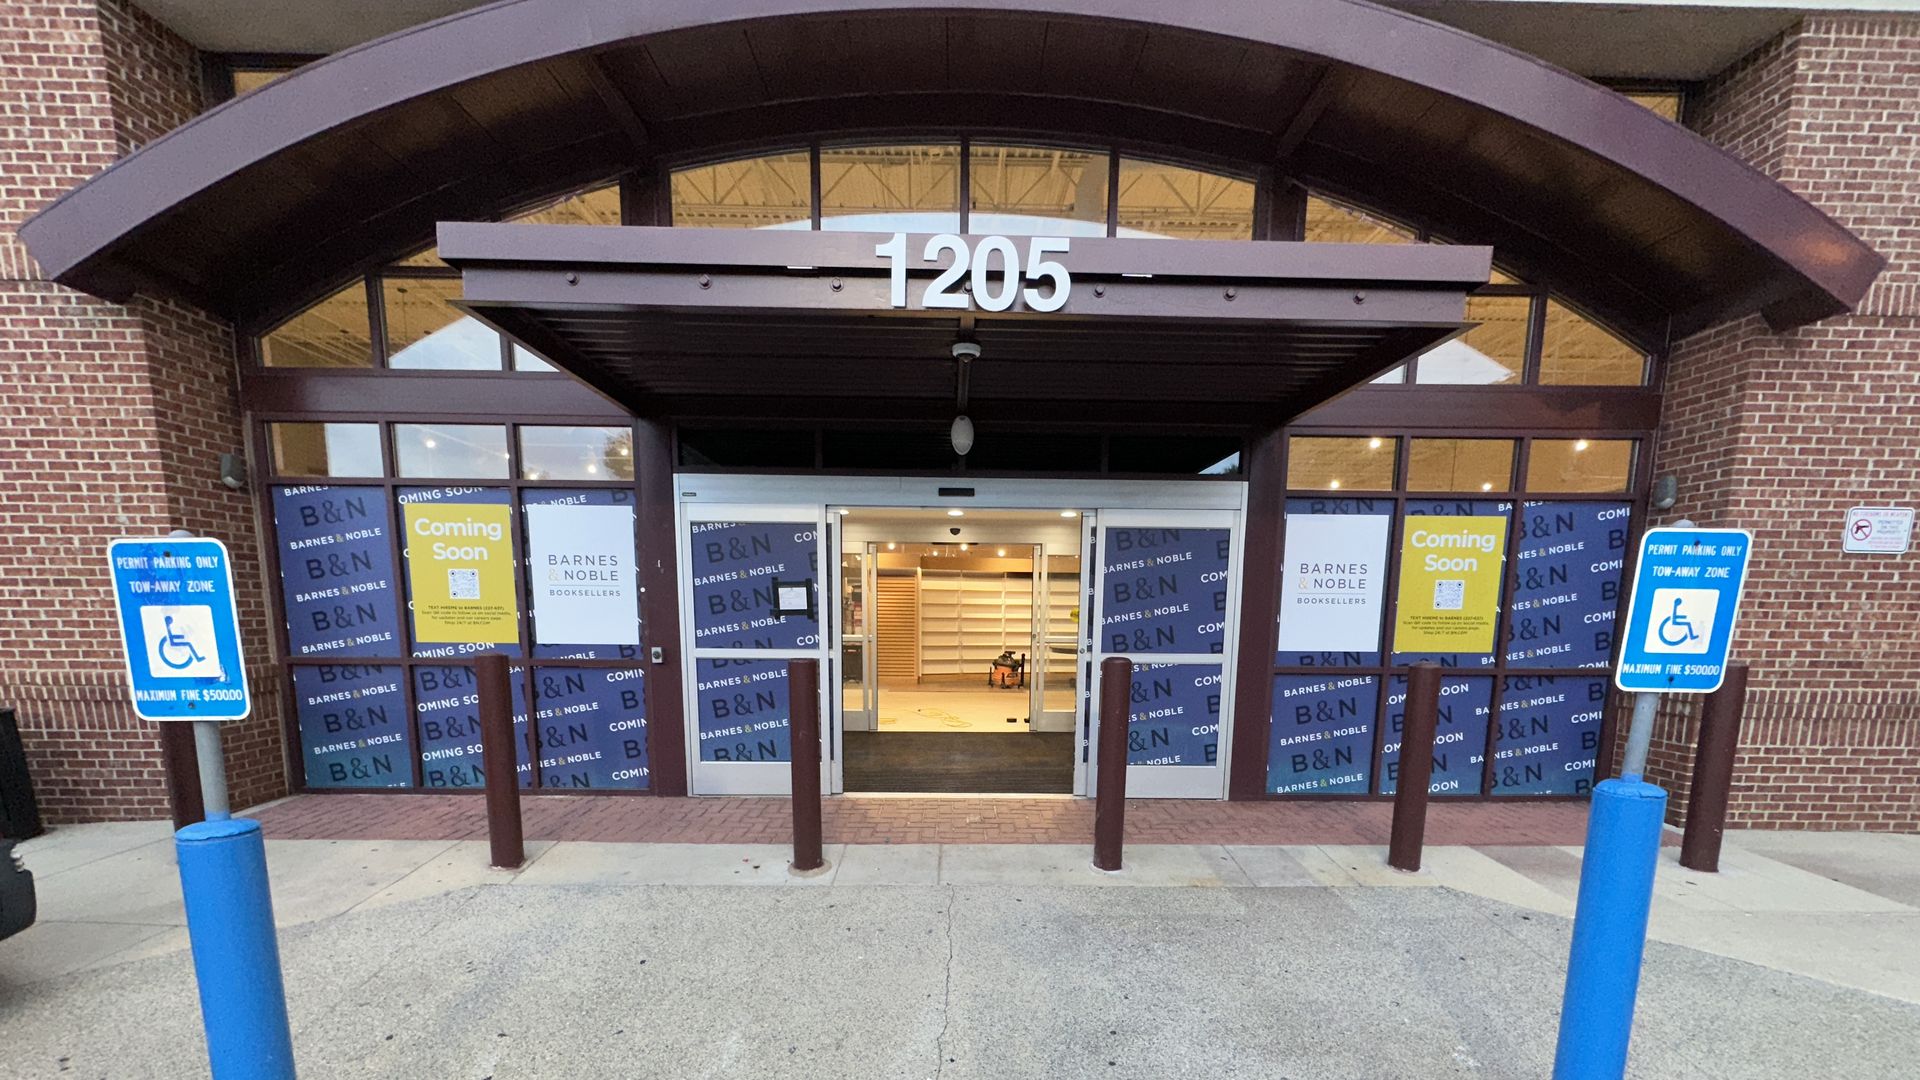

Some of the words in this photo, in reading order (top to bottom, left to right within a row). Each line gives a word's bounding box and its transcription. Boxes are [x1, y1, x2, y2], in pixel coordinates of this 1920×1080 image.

[876, 232, 1071, 312] 1205
[398, 490, 441, 504] OMING
[1598, 508, 1630, 521] COMI
[415, 518, 502, 540] Coming
[290, 536, 334, 550] BARNES
[336, 534, 344, 543] &
[346, 528, 382, 540] NOBLE
[1411, 530, 1496, 553] Coming
[433, 542, 488, 560] Soon
[1539, 548, 1546, 557] &
[1549, 542, 1584, 554] NOBLE
[1648, 545, 1678, 555] PERMIT
[1682, 545, 1716, 556] PARKING
[1721, 546, 1742, 557] ONLY
[117, 557, 148, 569] PERMIT
[154, 557, 191, 569] PARKING
[196, 556, 218, 568] ONLY
[549, 555, 618, 566] BARNES
[1103, 560, 1144, 574] BARNES
[1147, 558, 1154, 566] &
[1156, 552, 1192, 565] NOBLE
[1424, 555, 1477, 571] Soon
[1591, 560, 1623, 573] COMI
[548, 570, 558, 581] &
[564, 570, 618, 581] NOBLE
[694, 572, 738, 586] BARNES
[740, 570, 747, 579] &
[750, 564, 785, 577] NOBLE
[1300, 564, 1368, 574] BARNES
[1653, 566, 1700, 577] TOW-AWAY
[1704, 567, 1730, 578] ZONE
[1200, 570, 1227, 583] COM
[129, 580, 180, 593] TOW-AWAY
[187, 580, 215, 592] ZONE
[1299, 578, 1308, 589] &
[1314, 579, 1366, 589] NOBLE
[296, 588, 340, 602] BARNES
[342, 586, 349, 595] &
[351, 580, 387, 594] NOBLE
[1542, 594, 1577, 606] NOBLE
[1144, 610, 1152, 618] &
[1154, 604, 1190, 616] NOBLE
[1584, 611, 1616, 624] COMI
[696, 624, 739, 637] BARNES
[741, 621, 749, 630] &
[751, 616, 786, 628] NOBLE
[1198, 622, 1224, 634] COM
[302, 640, 345, 654] BARNES
[347, 638, 354, 646] &
[356, 632, 392, 645] NOBLE
[412, 646, 454, 658] OMING
[458, 642, 495, 654] SOON
[1536, 644, 1571, 656] NOBLE
[1623, 663, 1661, 674] MAXIMUM
[1666, 664, 1681, 675] FINE
[698, 677, 741, 690] BARNES
[752, 669, 788, 682] NOBLE
[1194, 675, 1221, 687] COM
[1284, 684, 1326, 697] BARNES
[1328, 682, 1335, 690] &
[1337, 676, 1372, 689] NOBLE
[1439, 684, 1469, 696] OON
[136, 690, 177, 701] MAXIMUM
[181, 690, 200, 701] FINE
[308, 692, 351, 705] BARNES
[353, 690, 360, 698] &
[362, 684, 398, 696] NOBLE
[1530, 695, 1565, 706] NOBLE
[418, 698, 459, 712] OMING
[464, 694, 479, 705] SO
[554, 706, 562, 716] &
[564, 702, 599, 714] NOBLE
[1149, 707, 1184, 719] NOBLE
[1571, 711, 1602, 723] COMI
[700, 726, 742, 740] BARNES
[745, 724, 752, 733] &
[754, 719, 789, 732] NOBLE
[1192, 724, 1218, 735] COM
[1281, 733, 1322, 746] BARNES
[1324, 731, 1331, 739] &
[1333, 725, 1367, 738] NOBLE
[314, 741, 356, 755] BARNES
[368, 734, 402, 746] NOBLE
[1434, 733, 1464, 744] OON
[422, 748, 463, 761] OMING
[467, 744, 483, 754] SO
[1525, 743, 1559, 755] NOBLE
[558, 757, 566, 765] &
[568, 752, 602, 764] NOBLE
[1565, 759, 1595, 771] COMI
[1277, 781, 1318, 793] BARNES
[1320, 779, 1328, 787] &
[1330, 774, 1363, 786] NOBLE
[1428, 780, 1458, 793] OON
